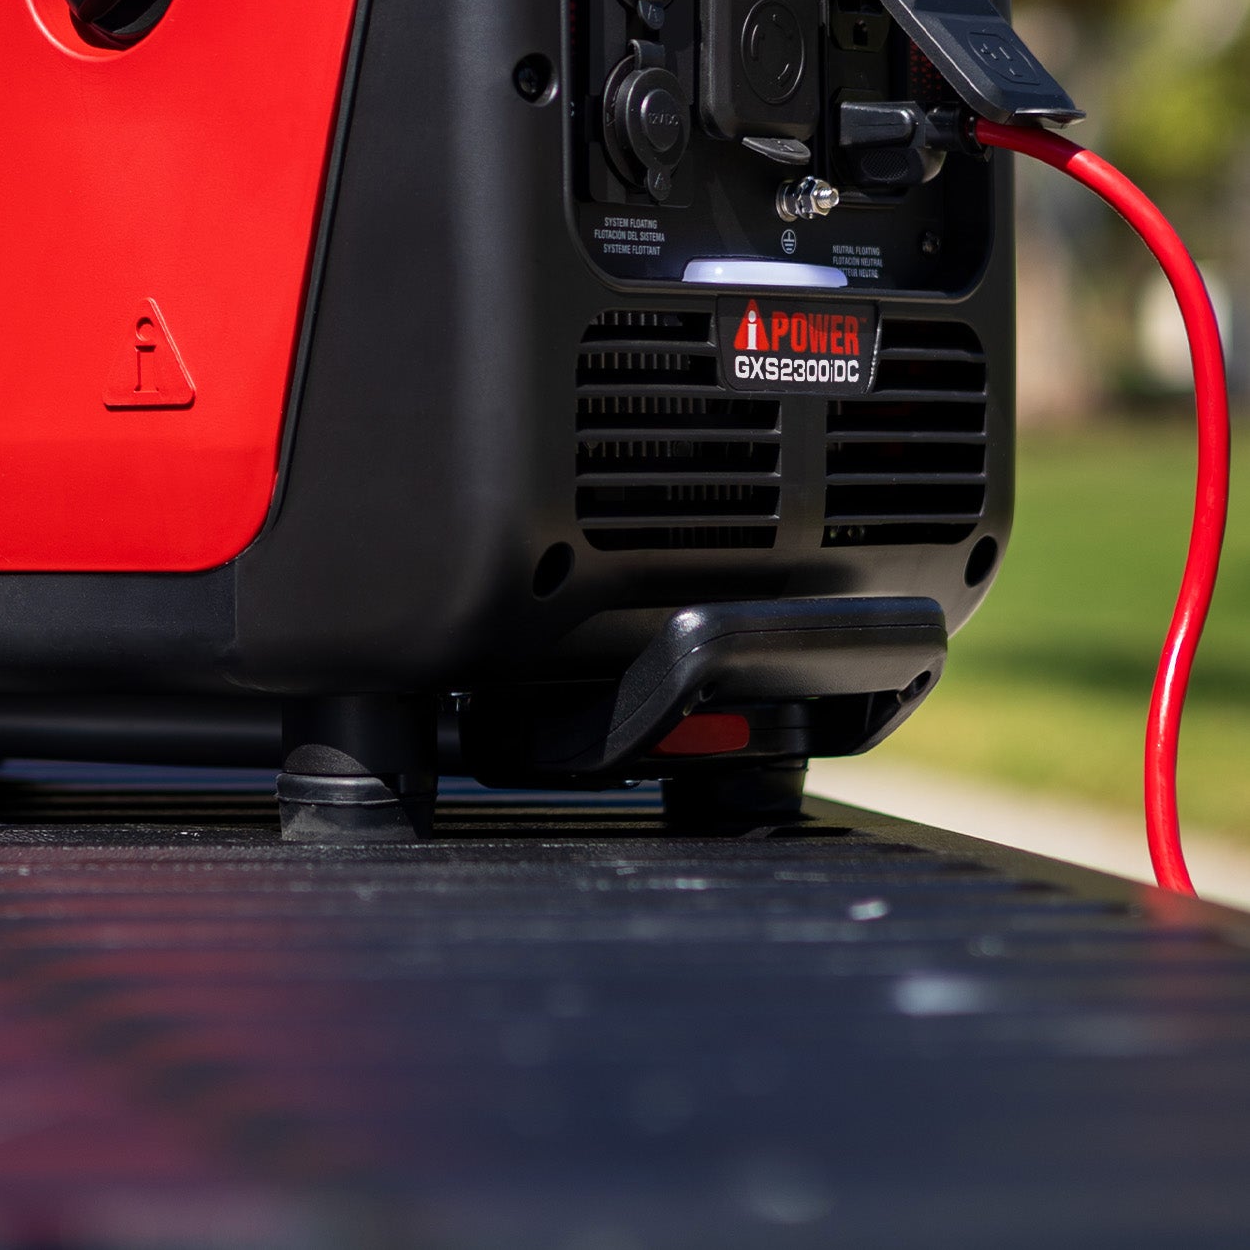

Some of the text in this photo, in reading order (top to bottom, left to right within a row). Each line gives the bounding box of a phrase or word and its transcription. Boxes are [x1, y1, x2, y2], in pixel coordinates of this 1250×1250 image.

[604, 216, 658, 230] SYSTEM FLOATING
[627, 230, 639, 241] DEL
[639, 231, 665, 243] SISTEMA
[632, 245, 661, 256] FLOTTANT
[832, 245, 880, 257] NEUTRAL FLOATING
[734, 355, 860, 383] GXS2300iDC
